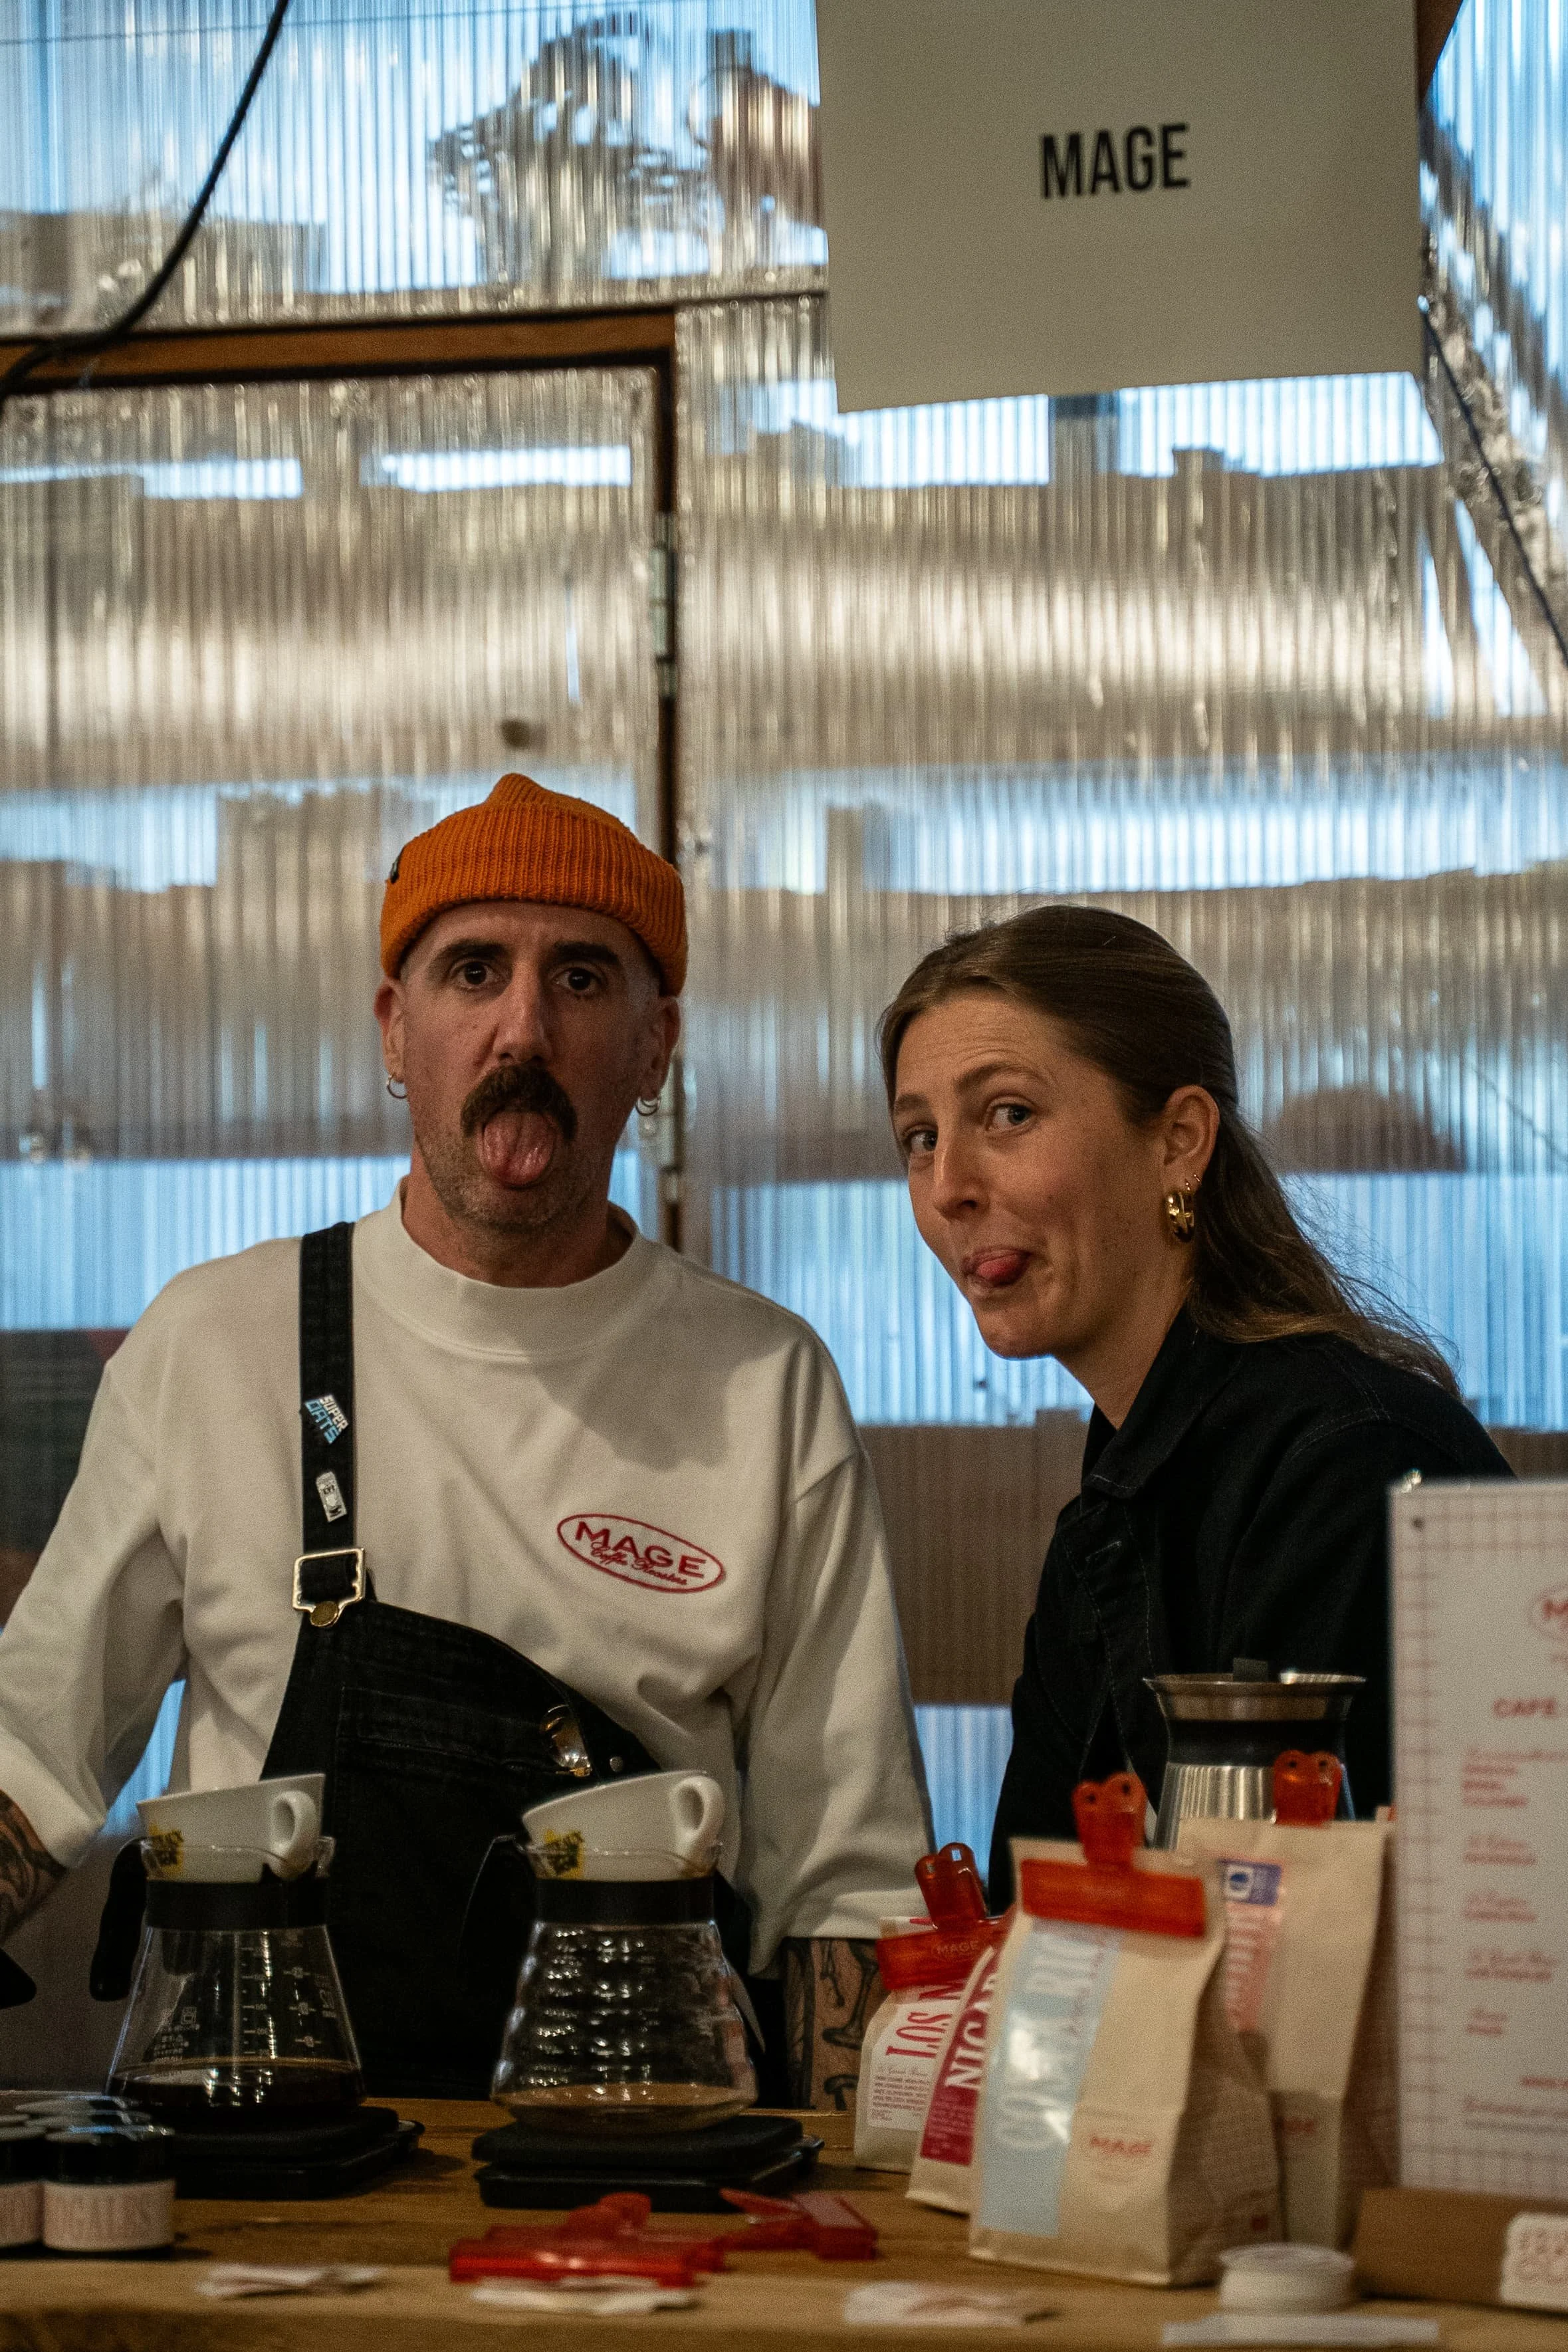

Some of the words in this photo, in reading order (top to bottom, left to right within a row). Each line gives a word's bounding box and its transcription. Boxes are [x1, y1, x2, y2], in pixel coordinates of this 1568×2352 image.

[1042, 122, 1190, 199] MAGE
[305, 1400, 339, 1444] OATS
[574, 1520, 707, 1578] MAGE
[936, 1940, 979, 1954] MAGE
[886, 2012, 952, 2059] LOS
